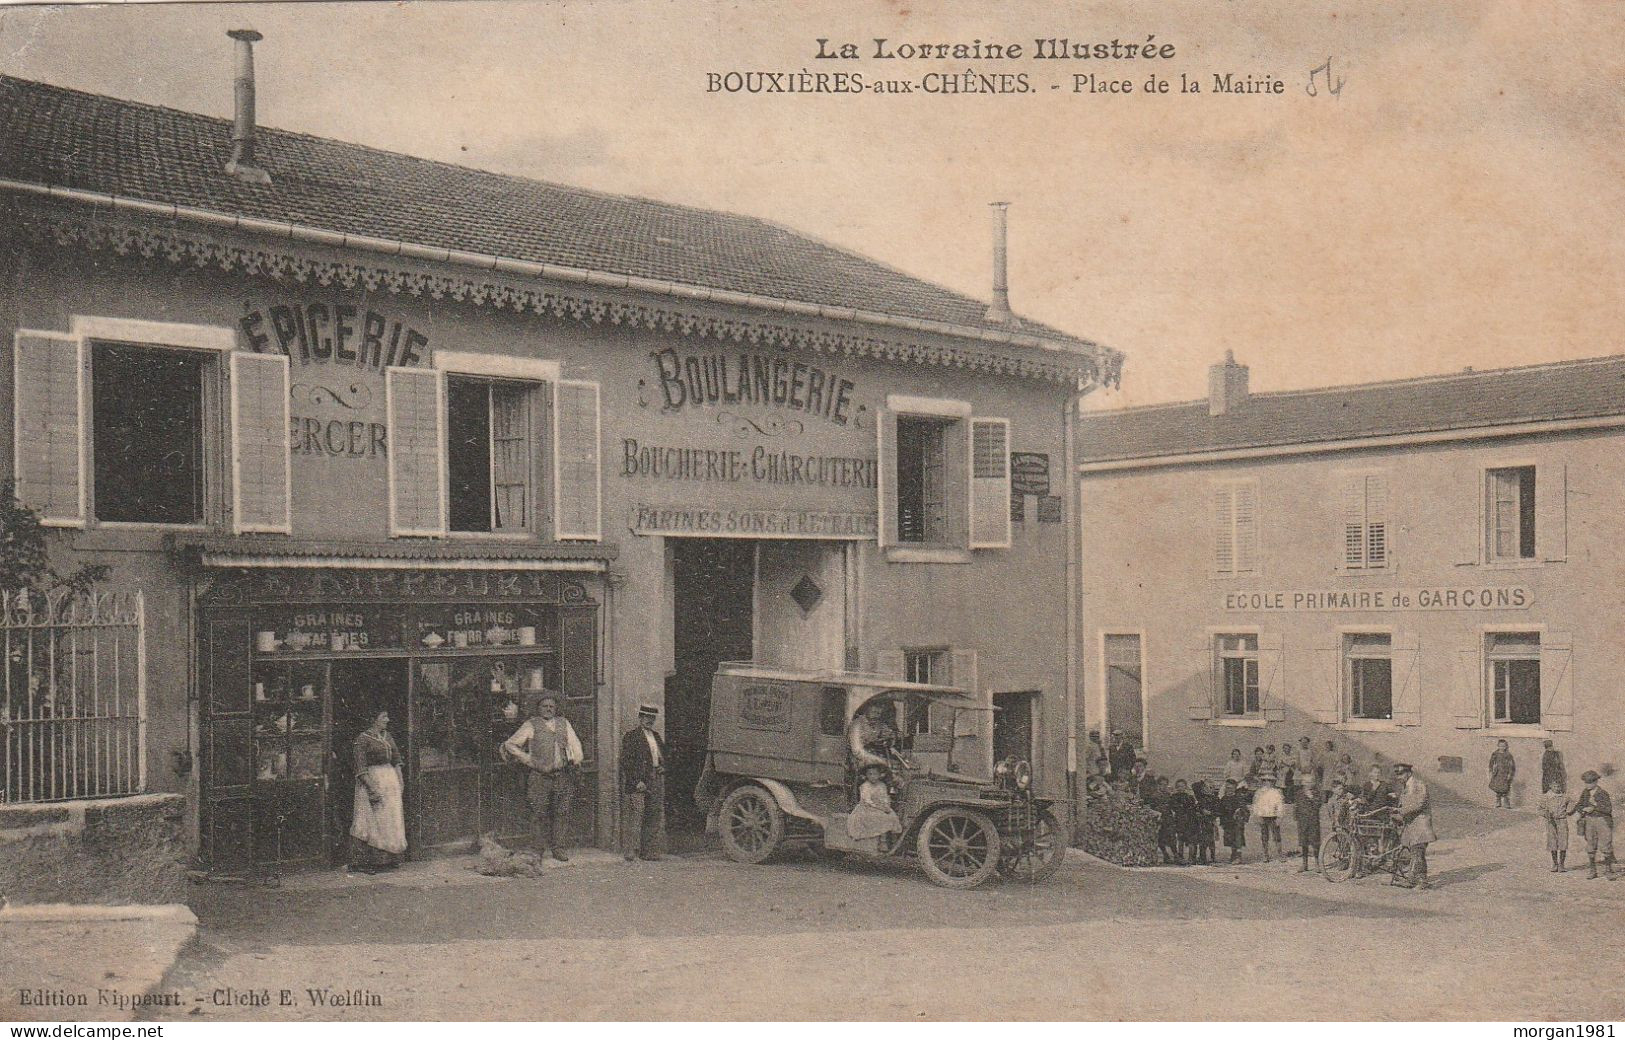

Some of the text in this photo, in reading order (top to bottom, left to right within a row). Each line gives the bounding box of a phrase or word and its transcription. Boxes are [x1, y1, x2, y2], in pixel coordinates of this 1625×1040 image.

[650, 348, 854, 426] BOULANGERIE
[290, 416, 387, 455] ERCER
[635, 505, 721, 531] FARINES
[725, 509, 778, 533] SONS
[1226, 594, 1284, 609] ECOLE
[1294, 592, 1385, 609] PRIMAIRE
[1392, 591, 1411, 608] de
[294, 614, 364, 627] GRAINES
[454, 611, 514, 625] GRAINES
